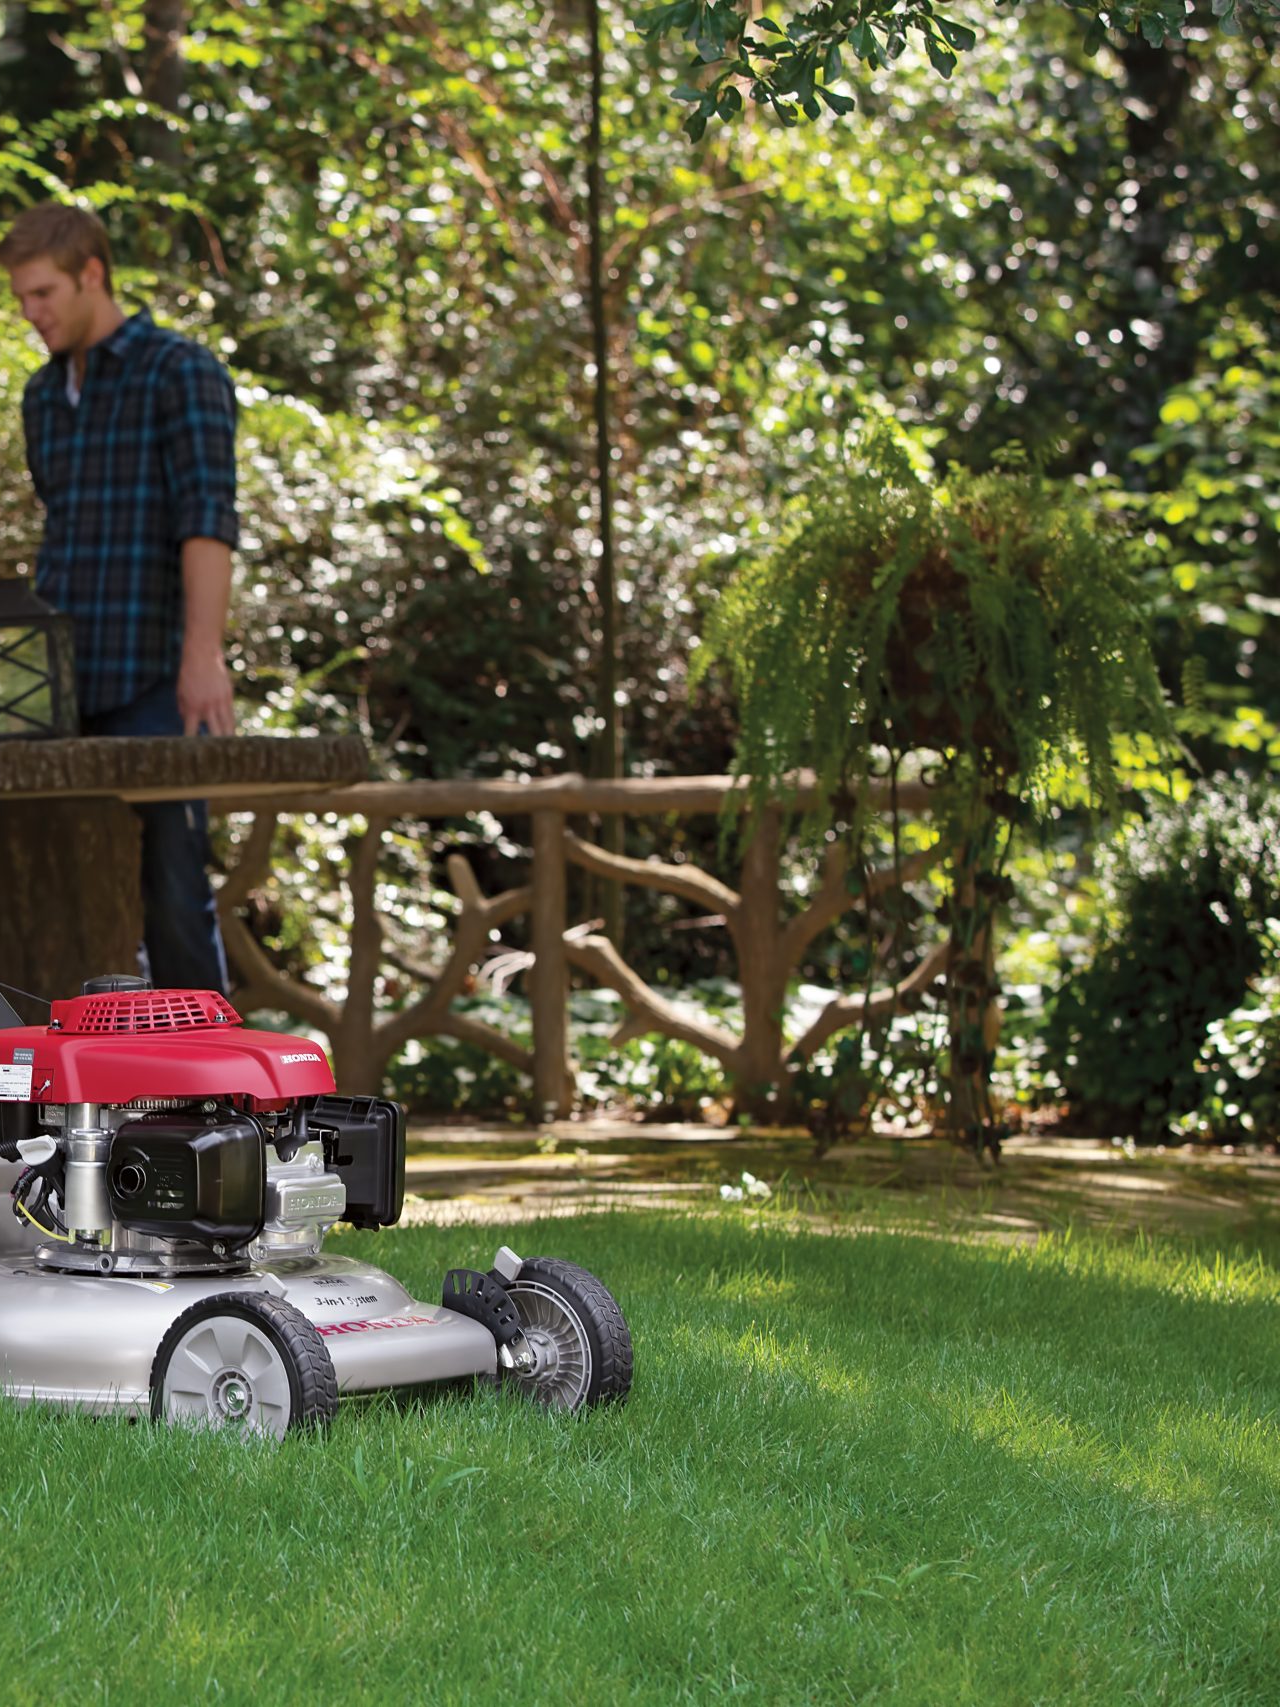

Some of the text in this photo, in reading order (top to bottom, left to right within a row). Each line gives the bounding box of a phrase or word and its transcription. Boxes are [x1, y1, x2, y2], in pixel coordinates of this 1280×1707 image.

[280, 1053, 321, 1064] HONDA
[288, 1196, 343, 1211] HONDA
[315, 1295, 378, 1307] 3-in-1 System
[315, 1315, 438, 1336] HONDA
